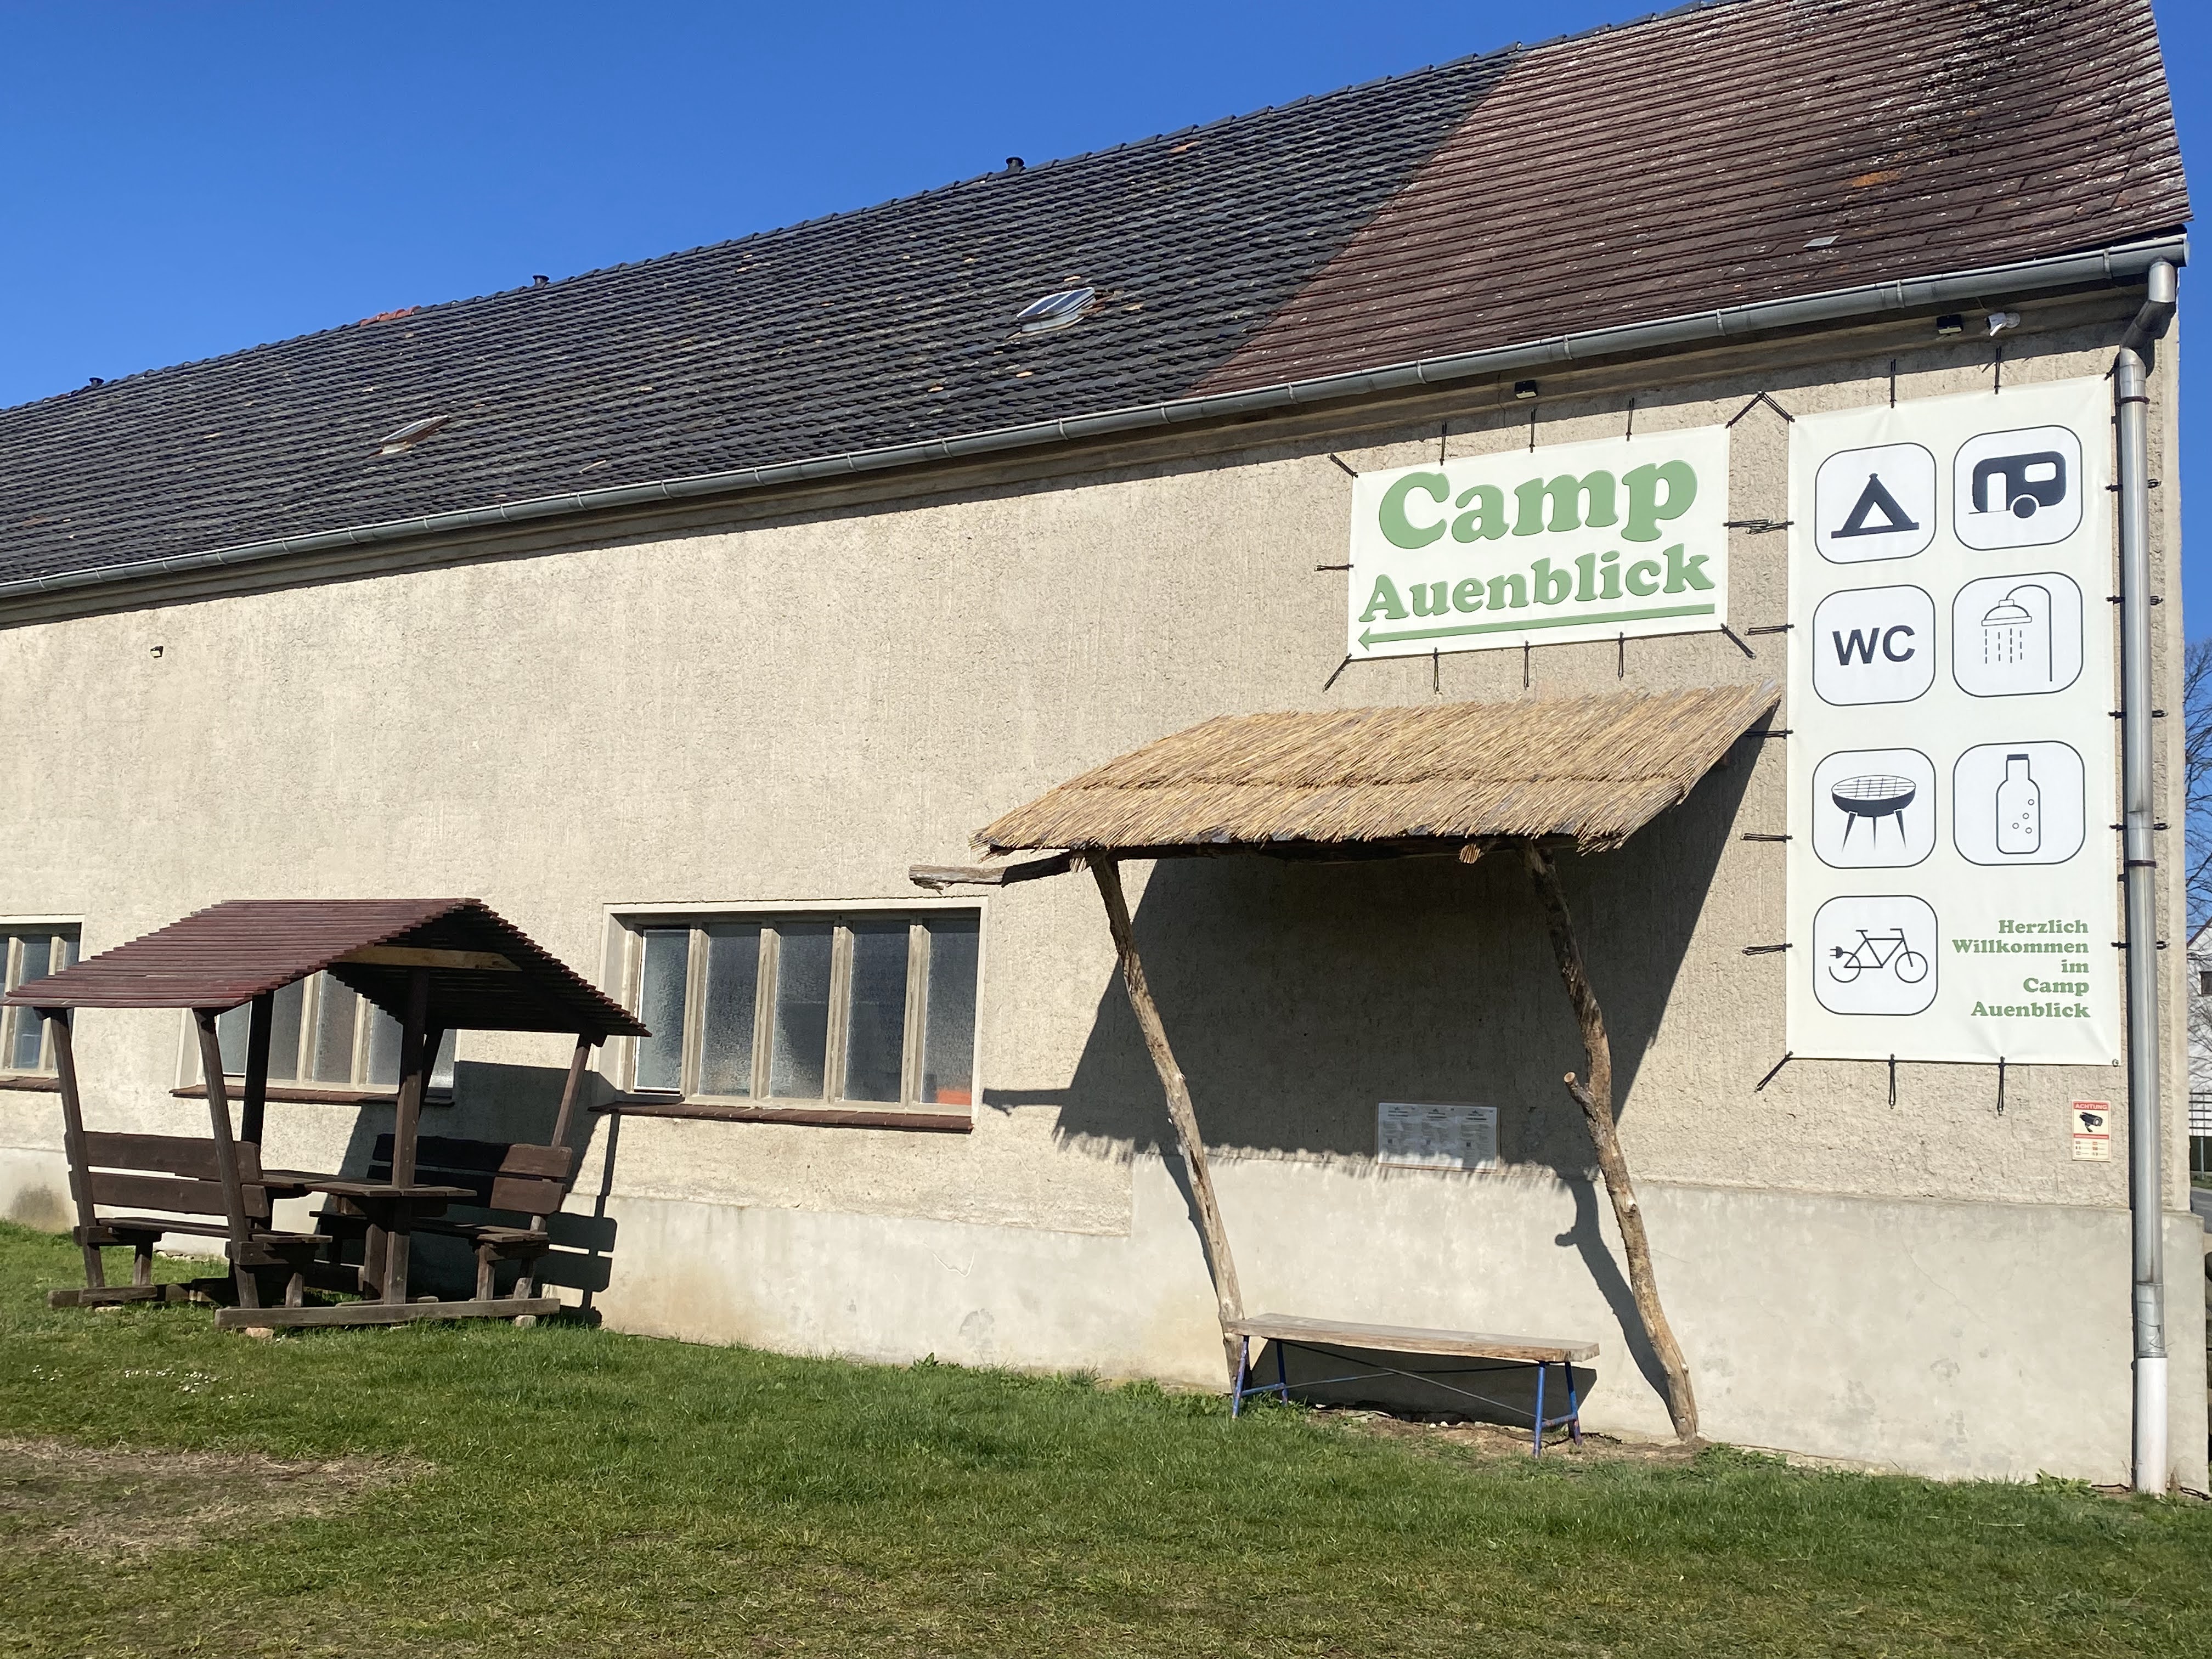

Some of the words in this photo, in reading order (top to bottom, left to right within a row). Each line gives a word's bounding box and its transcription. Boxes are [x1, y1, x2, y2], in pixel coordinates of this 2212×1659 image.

[1379, 460, 1697, 549] Camp
[1358, 543, 1716, 622] Auenblick
[1832, 625, 1915, 666] WC
[1998, 919, 2089, 934] Herzlich
[1952, 939, 2090, 953] Willkommen
[2061, 959, 2090, 973] im
[2023, 978, 2090, 996] Camp
[1971, 1001, 2091, 1018] Auenblick
